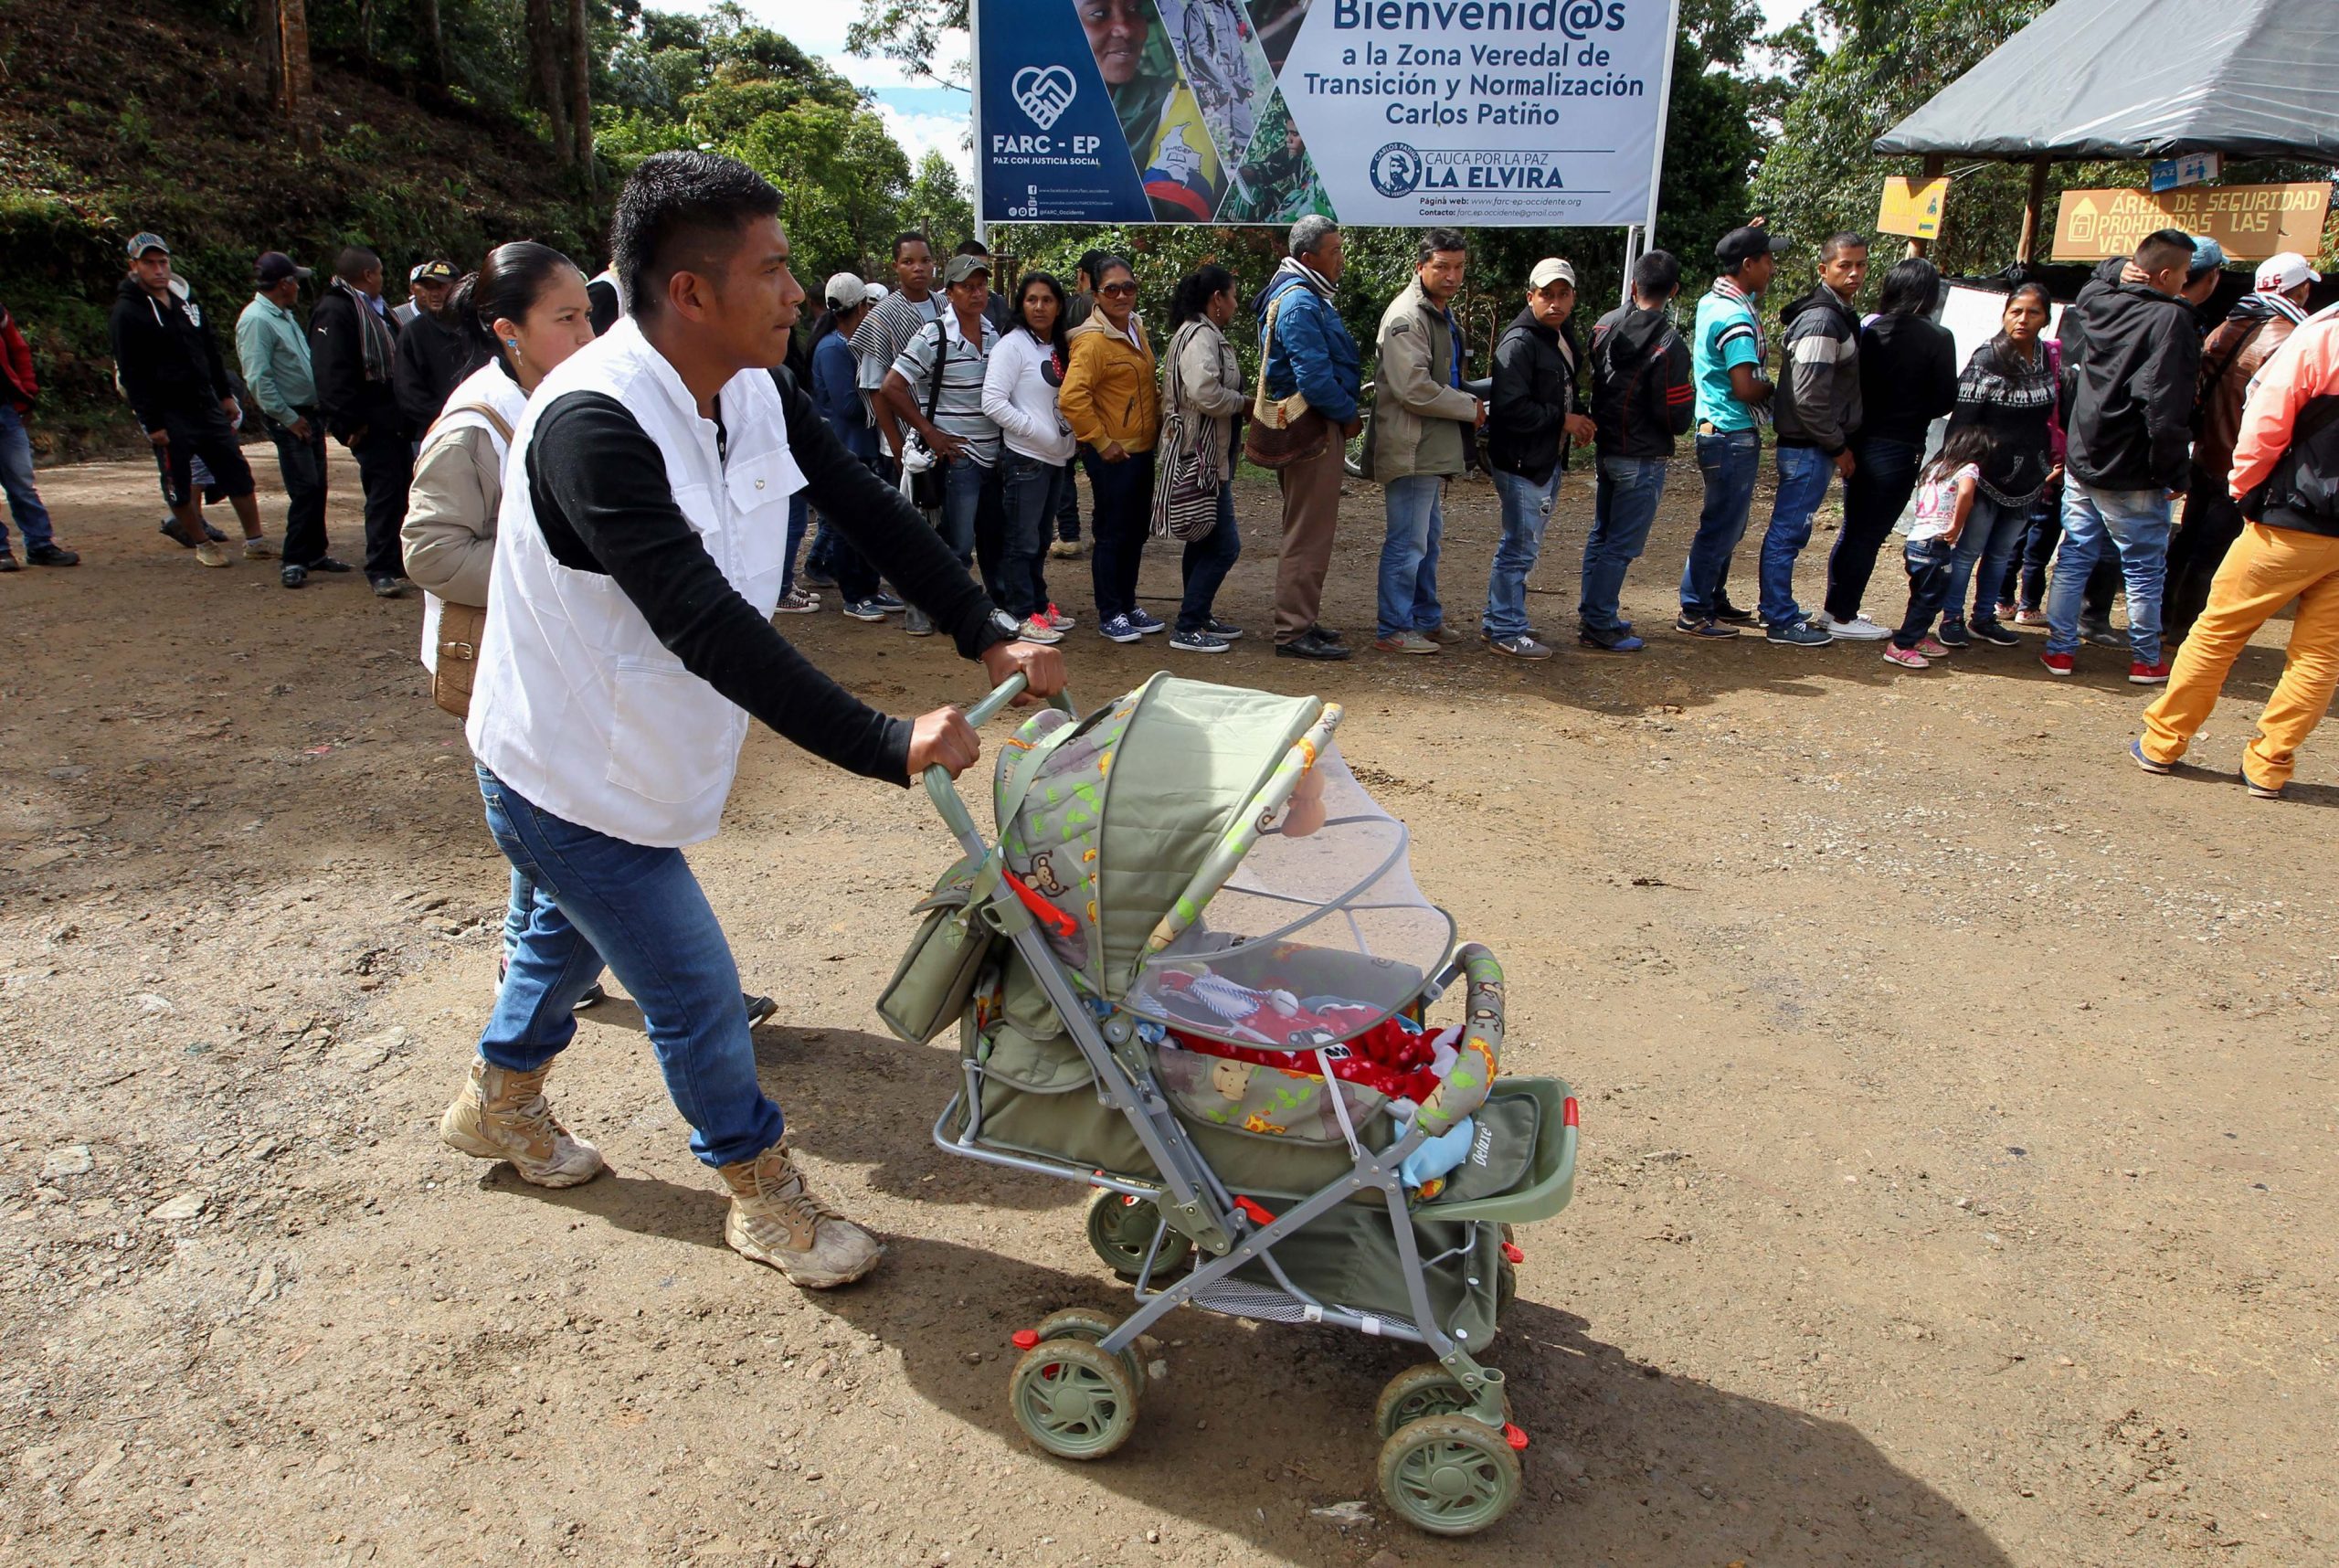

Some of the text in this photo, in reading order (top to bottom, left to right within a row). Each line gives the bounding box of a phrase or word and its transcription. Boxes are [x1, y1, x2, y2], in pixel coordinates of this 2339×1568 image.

[1334, 0, 1625, 39] Bienvenid@s
[1342, 42, 1610, 67] a la Zona Veredal de
[1304, 71, 1644, 101] Transición y Normalización
[1386, 101, 1560, 125] Carlos Patiño
[993, 135, 1051, 154] FARC
[1074, 136, 1100, 154] EP
[1032, 157, 1068, 165] JUSTICIA
[1425, 153, 1550, 165] CAUCA POR LA PAZ
[1425, 166, 1563, 188] LA ELVIRA
[1419, 208, 1455, 217] Contacto:
[1420, 196, 1446, 207] Página
[2110, 190, 2321, 215] ÁREA DE SEGURIDAD
[2098, 212, 2270, 234] PROHIBIDAS LAS
[1472, 1127, 1493, 1167] Deluxe
